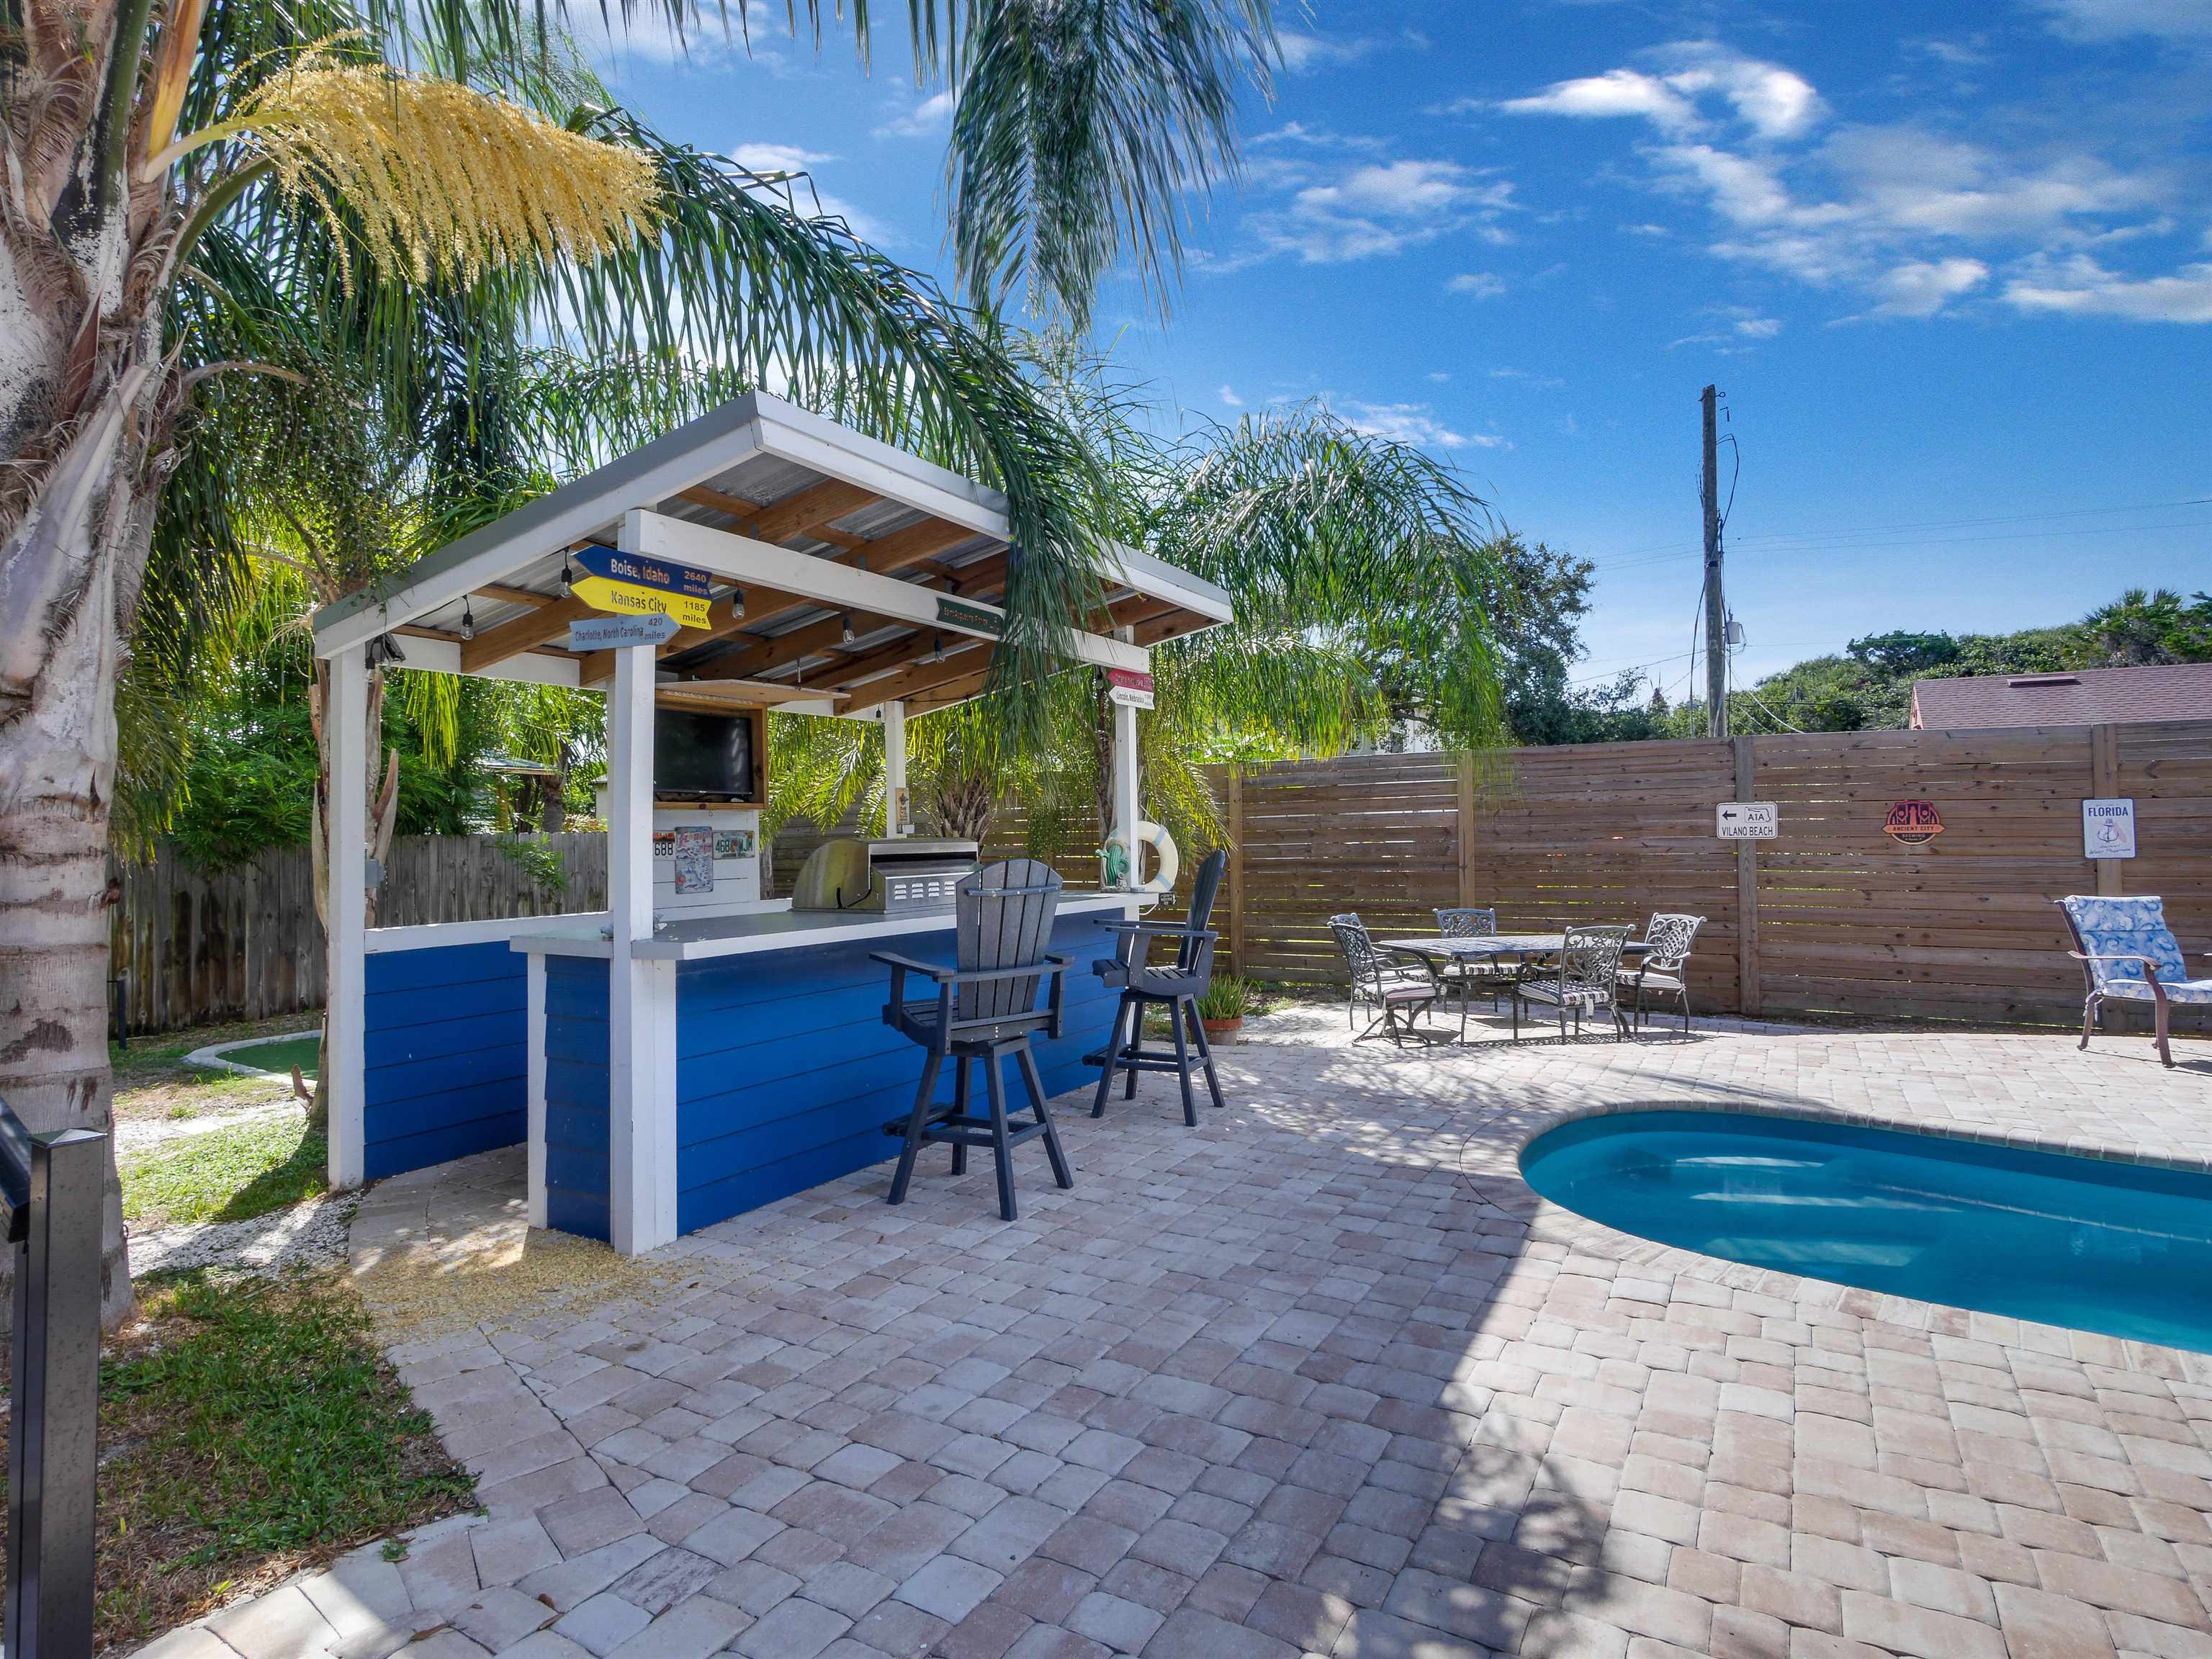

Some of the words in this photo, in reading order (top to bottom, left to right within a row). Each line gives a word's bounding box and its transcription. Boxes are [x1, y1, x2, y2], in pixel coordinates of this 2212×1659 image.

[611, 559, 641, 579] Boise,
[642, 565, 670, 585] Idaho
[684, 570, 706, 583] 2640
[683, 584, 709, 595] miles
[611, 590, 646, 610] Kansas
[648, 597, 667, 613] City
[684, 601, 705, 612] 1185
[683, 613, 706, 624] miles
[603, 626, 620, 639] North
[621, 624, 644, 637] Carolina
[644, 631, 666, 640] miles
[2088, 806, 2128, 817] FLORIDA
[1722, 827, 1748, 836] VILANO
[1749, 827, 1773, 836] BEACH
